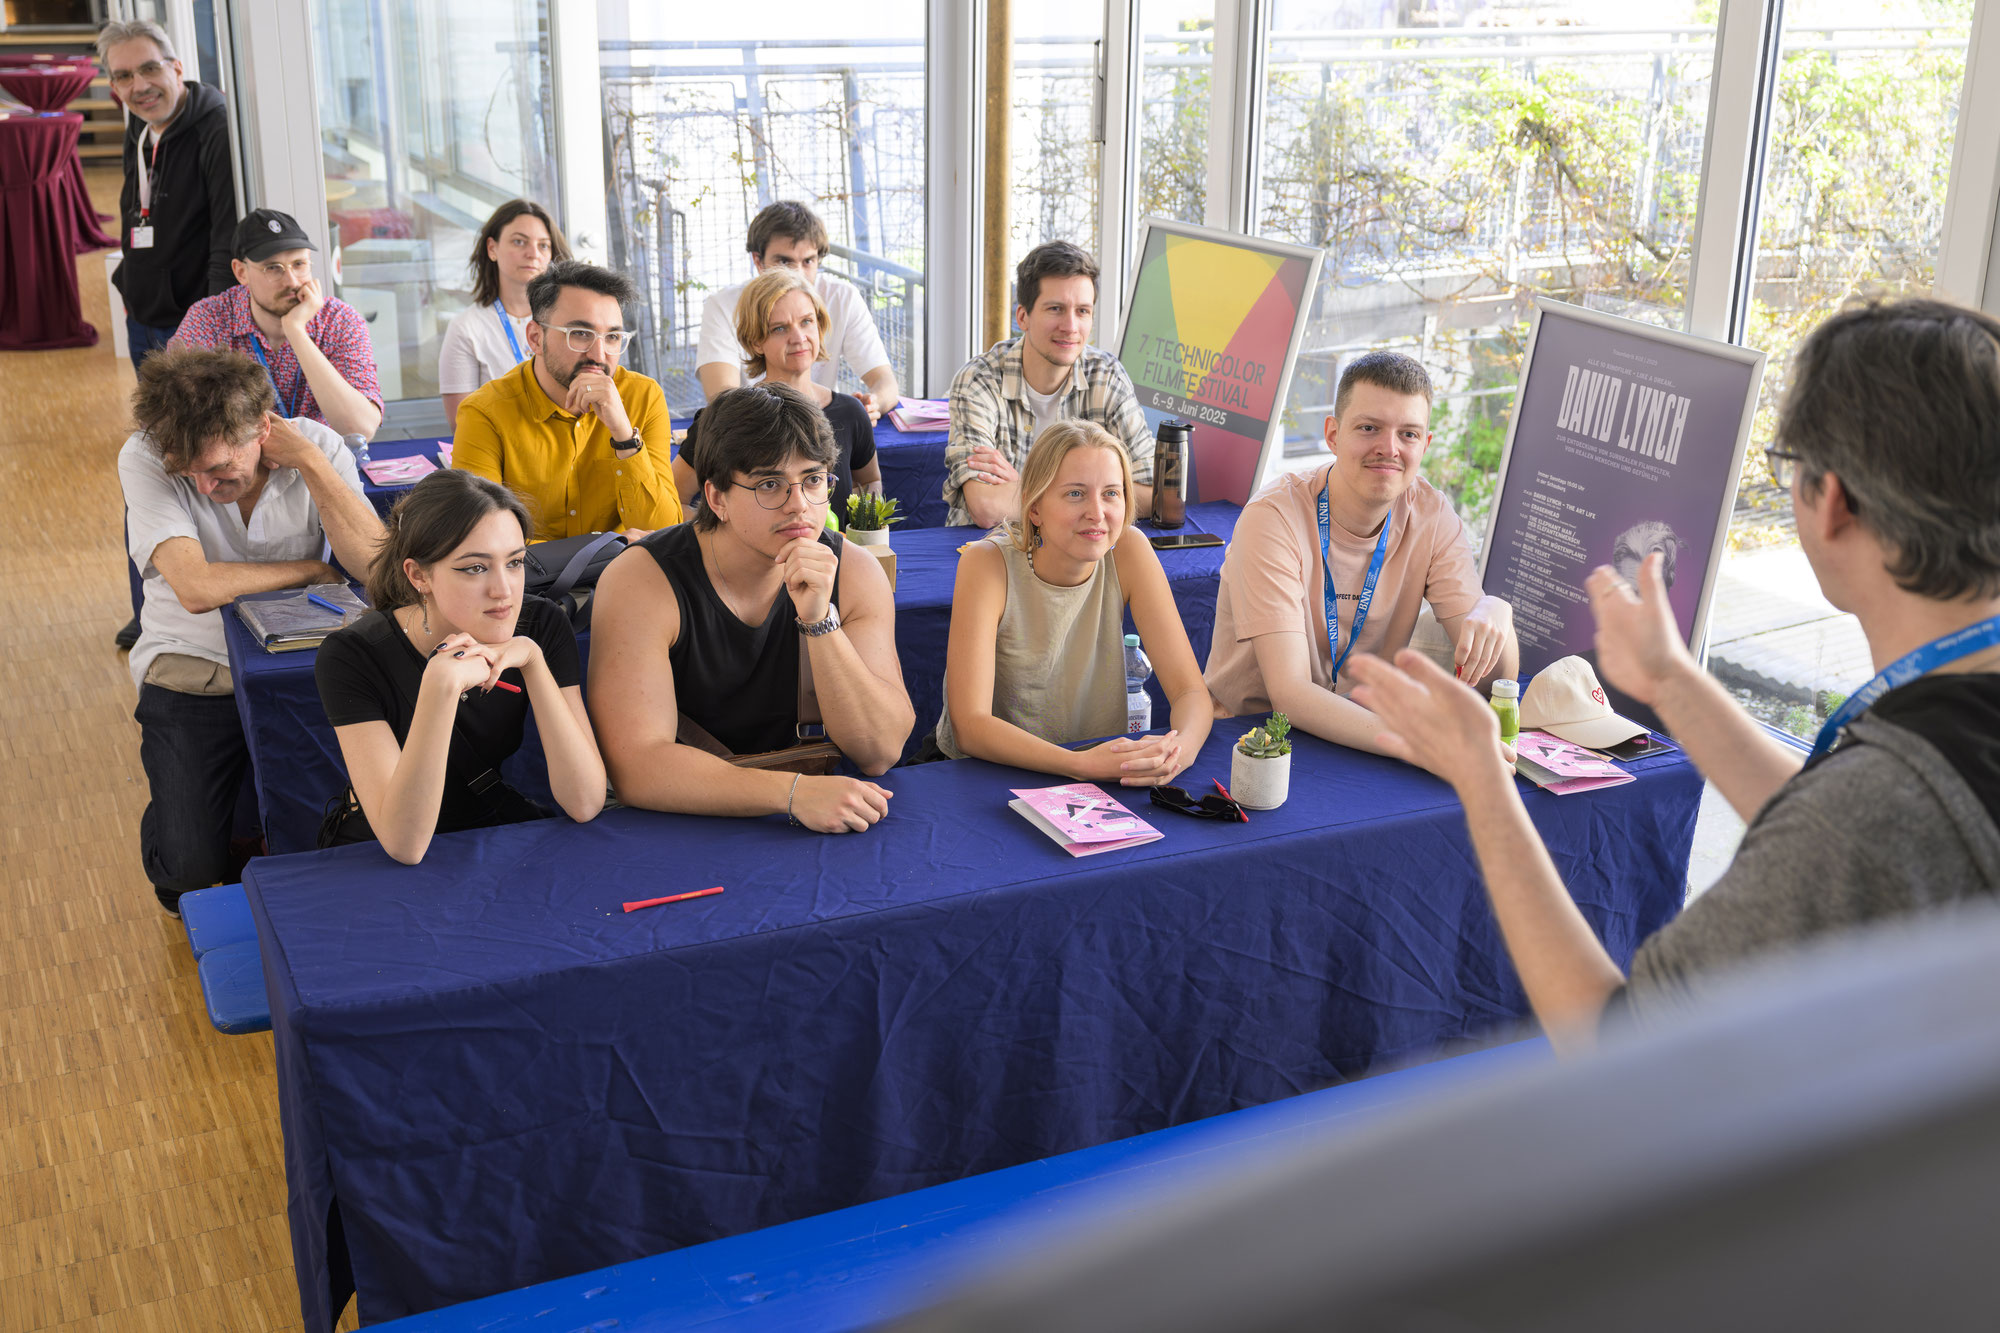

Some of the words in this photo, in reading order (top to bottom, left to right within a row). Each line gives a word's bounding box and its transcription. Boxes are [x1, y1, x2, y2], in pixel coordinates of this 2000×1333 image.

[1138, 334, 1150, 356] 7.
[1155, 336, 1266, 386] TECHNICOLOR
[1143, 360, 1248, 410] FILMFESTIVAL
[1178, 400, 1198, 418] Juni
[1200, 406, 1228, 425] 2025
[1556, 364, 1622, 442] DAVID
[1618, 382, 1690, 465] LYNCH
[1567, 438, 1598, 452] ENTDECKUNG
[1609, 451, 1638, 466] SURREALEN
[1575, 448, 1594, 460] REALEN
[1594, 455, 1620, 469] MENSCHEN
[1621, 463, 1631, 472] UND
[1632, 468, 1658, 482] GEFÜHLEN
[1320, 502, 1328, 524] BNN
[1531, 503, 1560, 519] ERASERHEAD
[1533, 492, 1546, 501] DAVID
[1546, 497, 1562, 506] LYNCH
[1566, 504, 1575, 512] THE
[1586, 510, 1596, 519] LIFE
[1537, 524, 1580, 545] ELEFANTENMENSCH
[1538, 518, 1561, 531] ELEPHANT
[1561, 527, 1572, 536] MAN
[1522, 543, 1534, 552] BLUE
[1534, 548, 1551, 559] VELVET
[1525, 532, 1537, 541] DUNE
[1550, 541, 1587, 560] WÜSTENPLANET
[1520, 558, 1530, 567] WILD
[1537, 565, 1552, 575] HEART
[1514, 581, 1526, 590] LOST
[1517, 569, 1528, 578] TWIN
[1544, 581, 1555, 590] FIRE
[1555, 585, 1568, 595] WALK
[1569, 592, 1581, 601] WITH
[1358, 588, 1372, 611] BNN
[1536, 612, 1565, 629] GESCHICHTE
[1542, 609, 1558, 619] STORY
[1328, 618, 1337, 640] BNN
[1537, 625, 1551, 635] DRIVE
